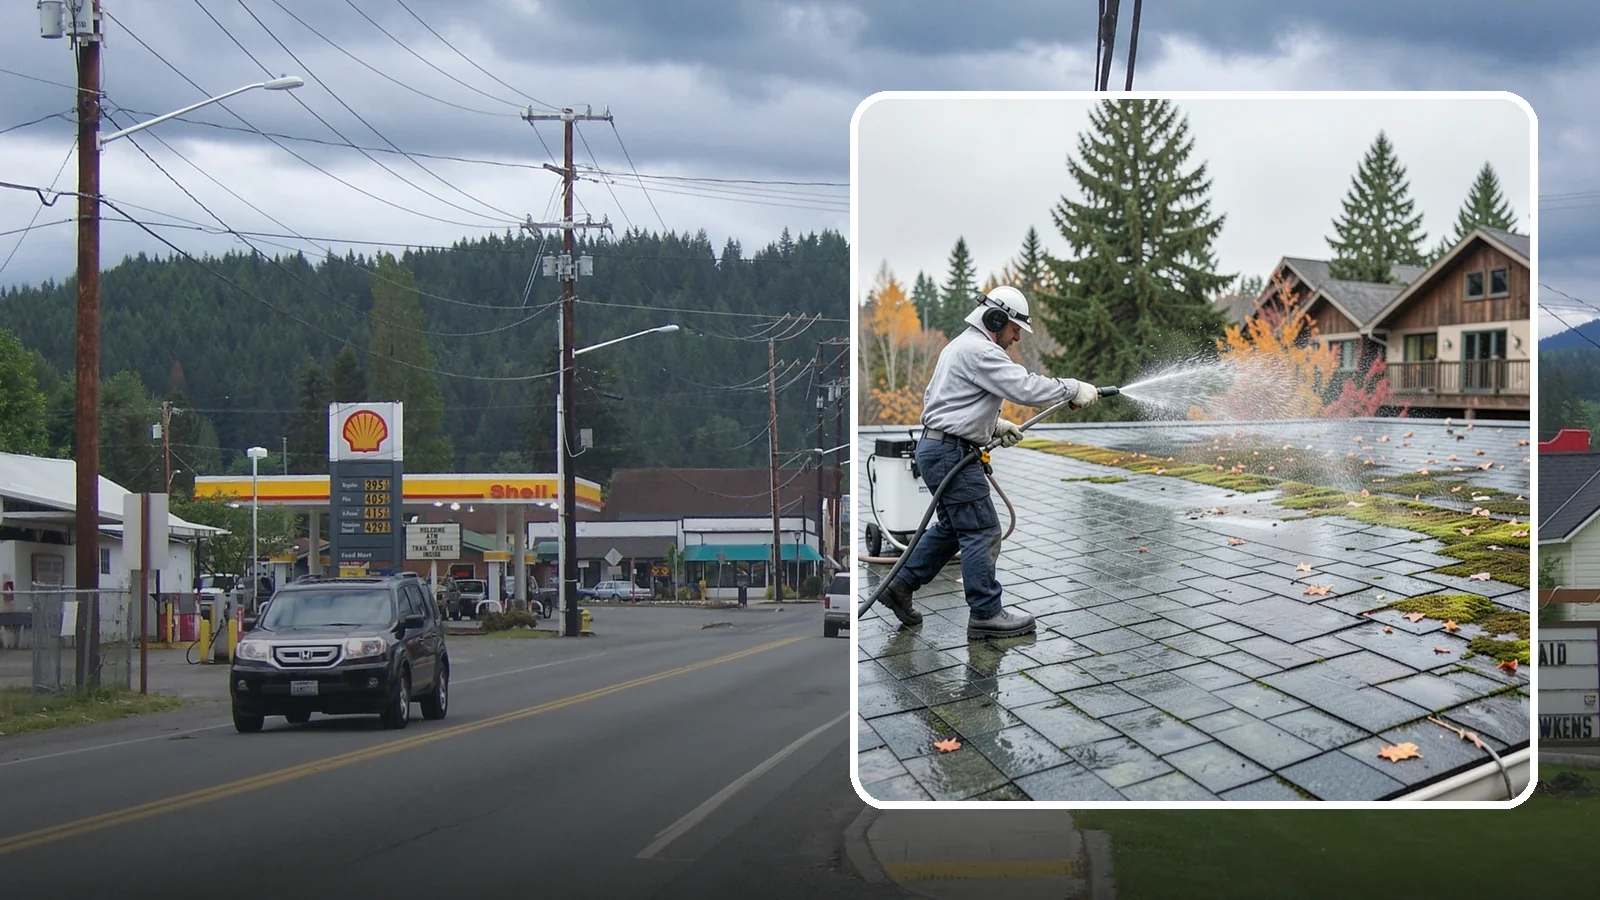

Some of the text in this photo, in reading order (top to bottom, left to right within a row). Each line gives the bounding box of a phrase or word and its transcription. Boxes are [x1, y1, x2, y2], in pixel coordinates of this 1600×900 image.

[366, 480, 384, 490] 395
[490, 484, 547, 499] Shell
[366, 494, 384, 504] 405
[366, 508, 383, 518] 415
[366, 522, 383, 532] 429
[1538, 642, 1567, 666] AID
